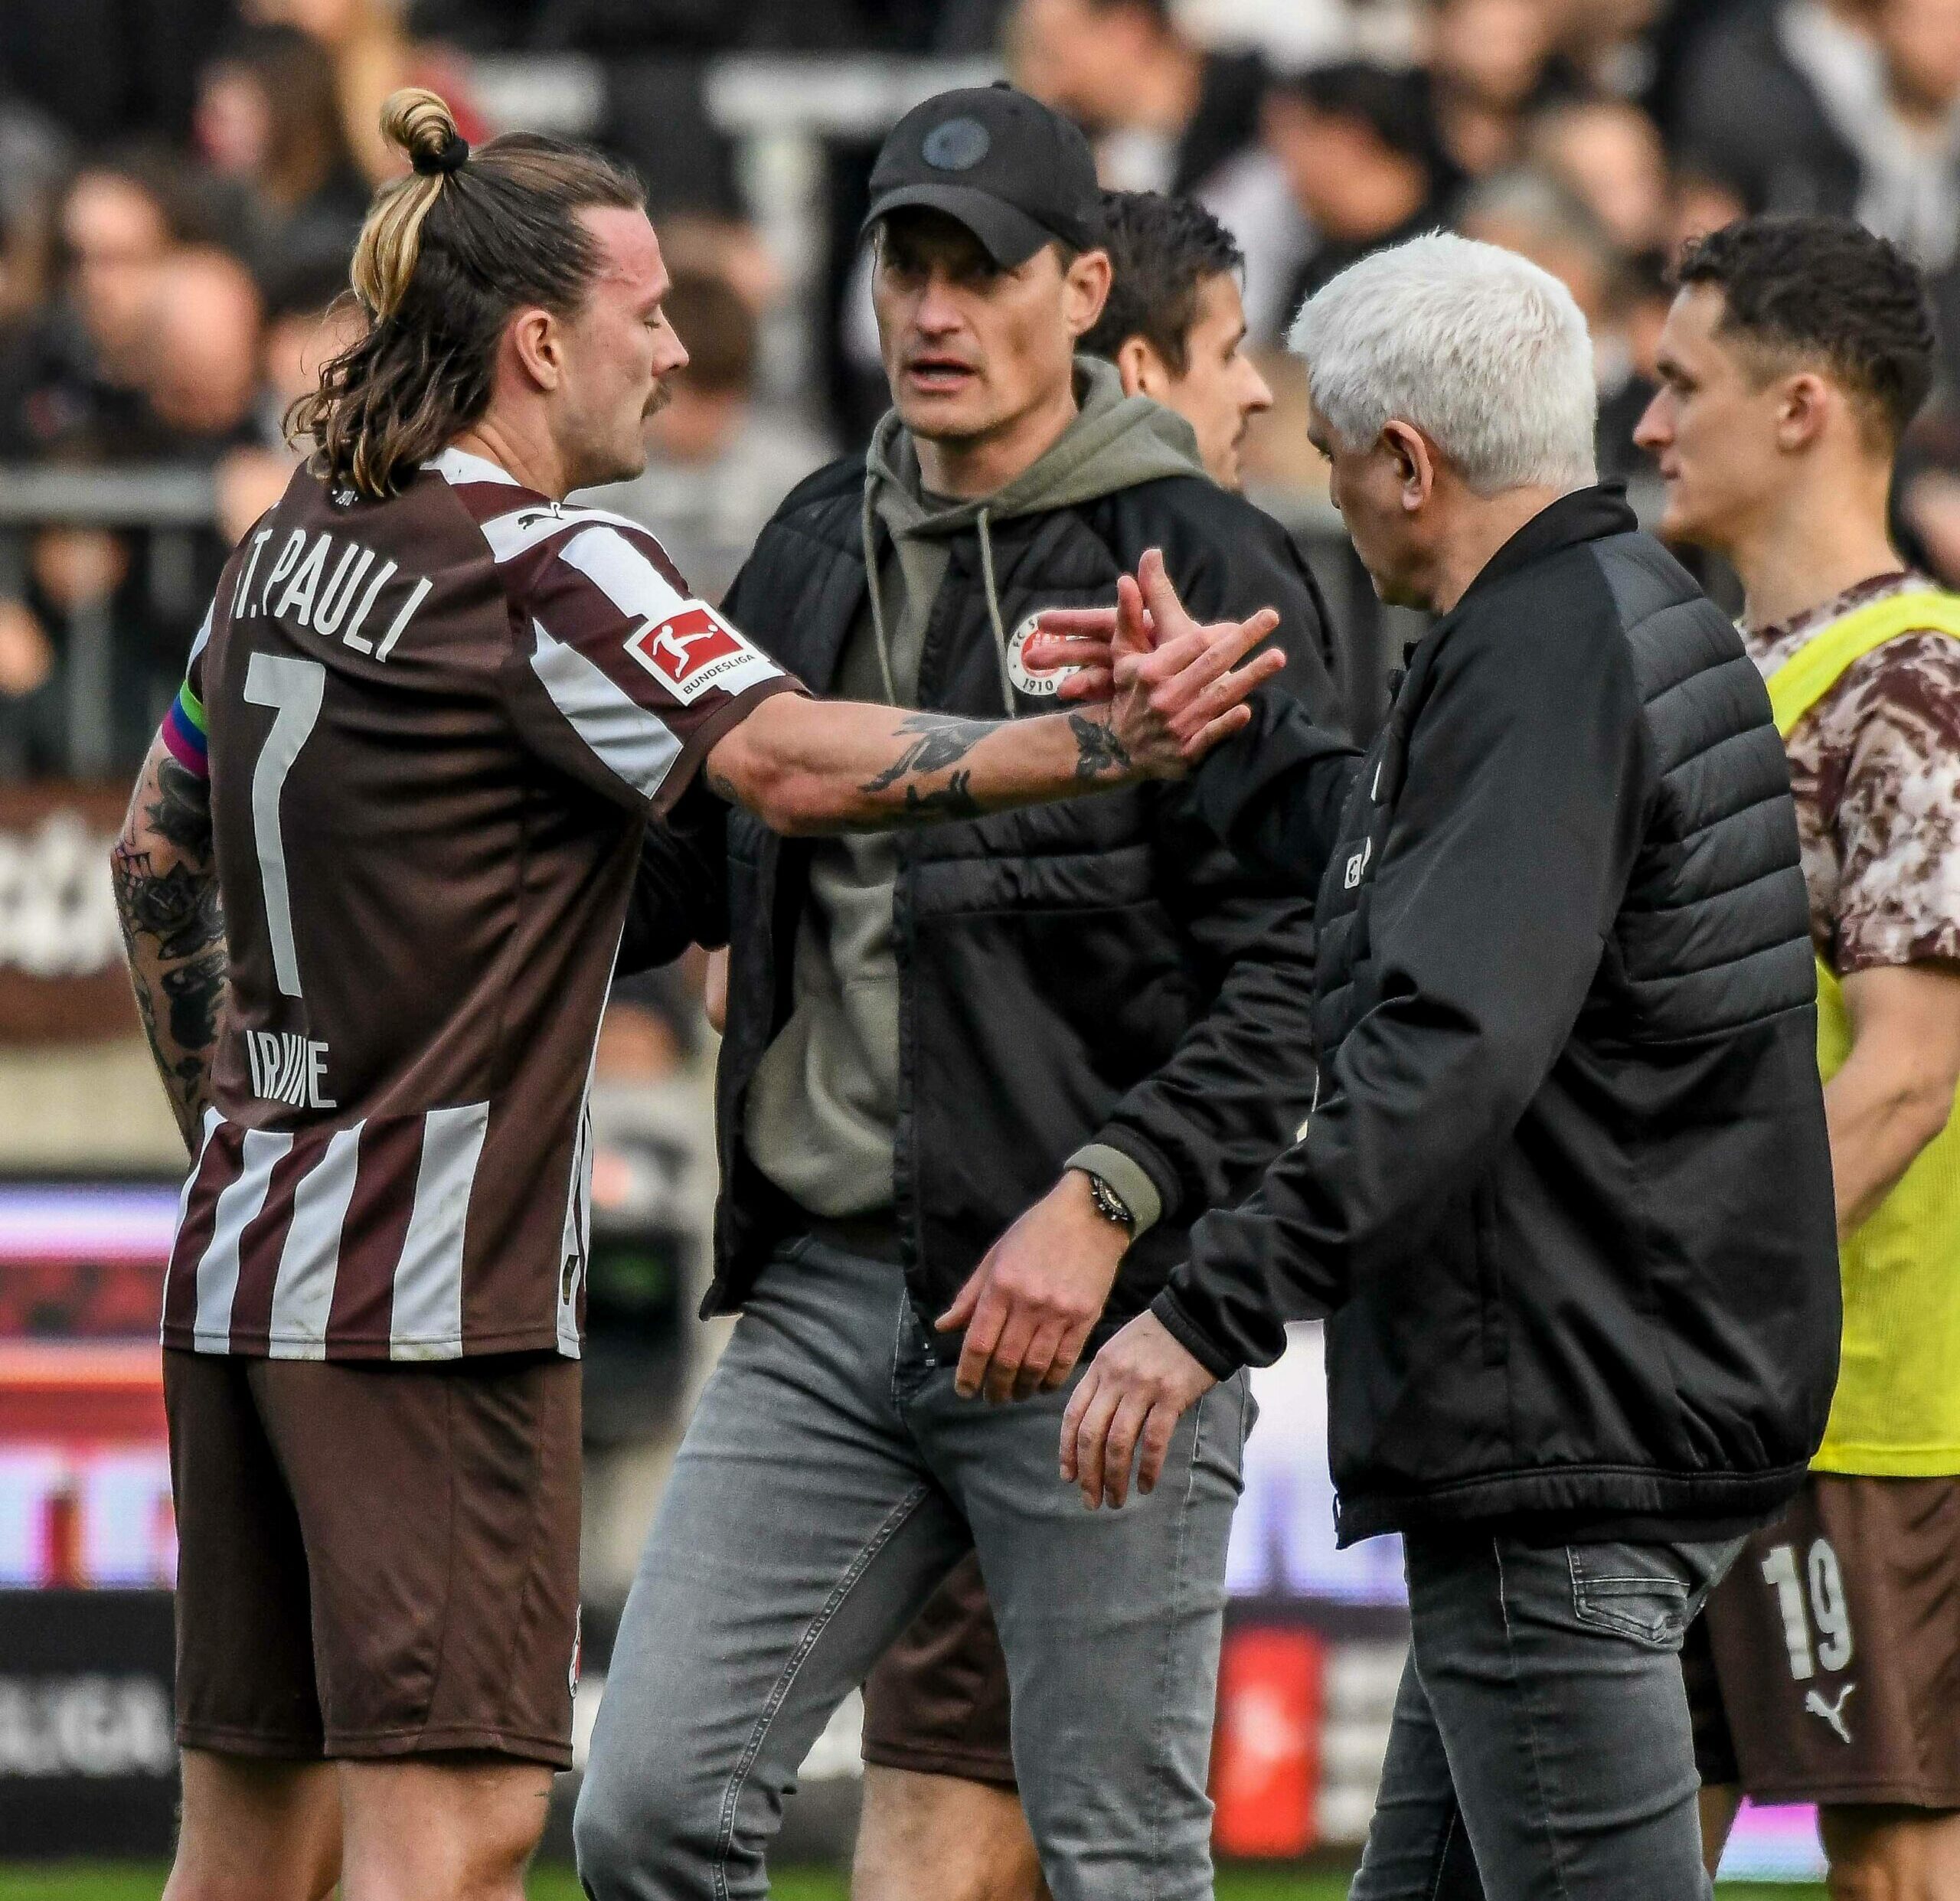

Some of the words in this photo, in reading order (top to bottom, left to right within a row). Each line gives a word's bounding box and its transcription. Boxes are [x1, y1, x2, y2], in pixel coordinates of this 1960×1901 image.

[682, 654, 756, 694] BUNDESLIGA
[1023, 678, 1054, 692] 1910
[243, 652, 325, 998] 7
[1762, 1539, 1851, 1680] 19
